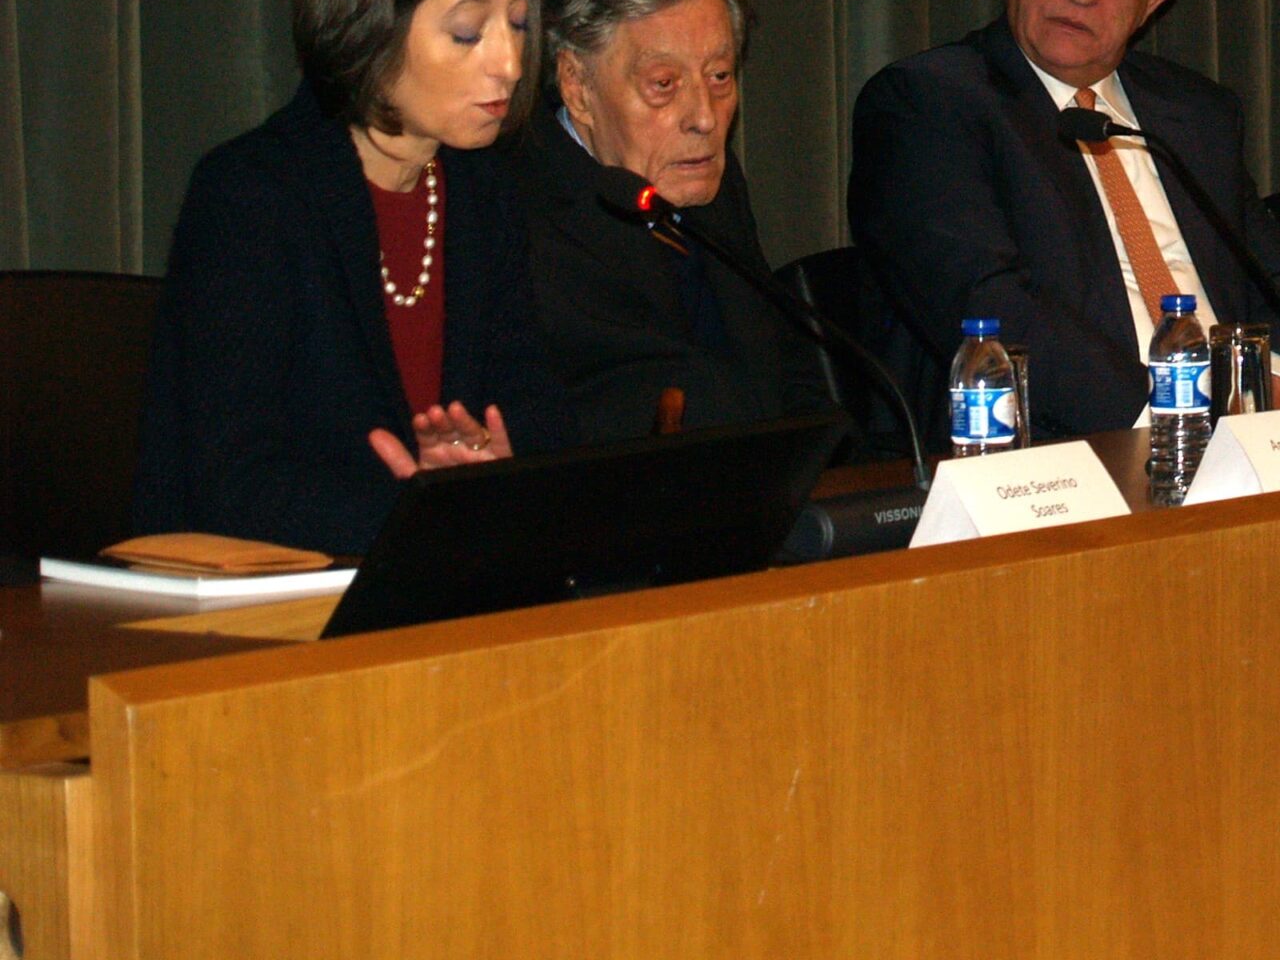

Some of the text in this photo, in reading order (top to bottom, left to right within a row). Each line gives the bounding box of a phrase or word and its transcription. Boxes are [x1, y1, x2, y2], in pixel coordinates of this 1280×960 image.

[996, 477, 1078, 500] Odete Severino
[874, 505, 923, 524] VISSONI
[1030, 503, 1069, 518] Soares
